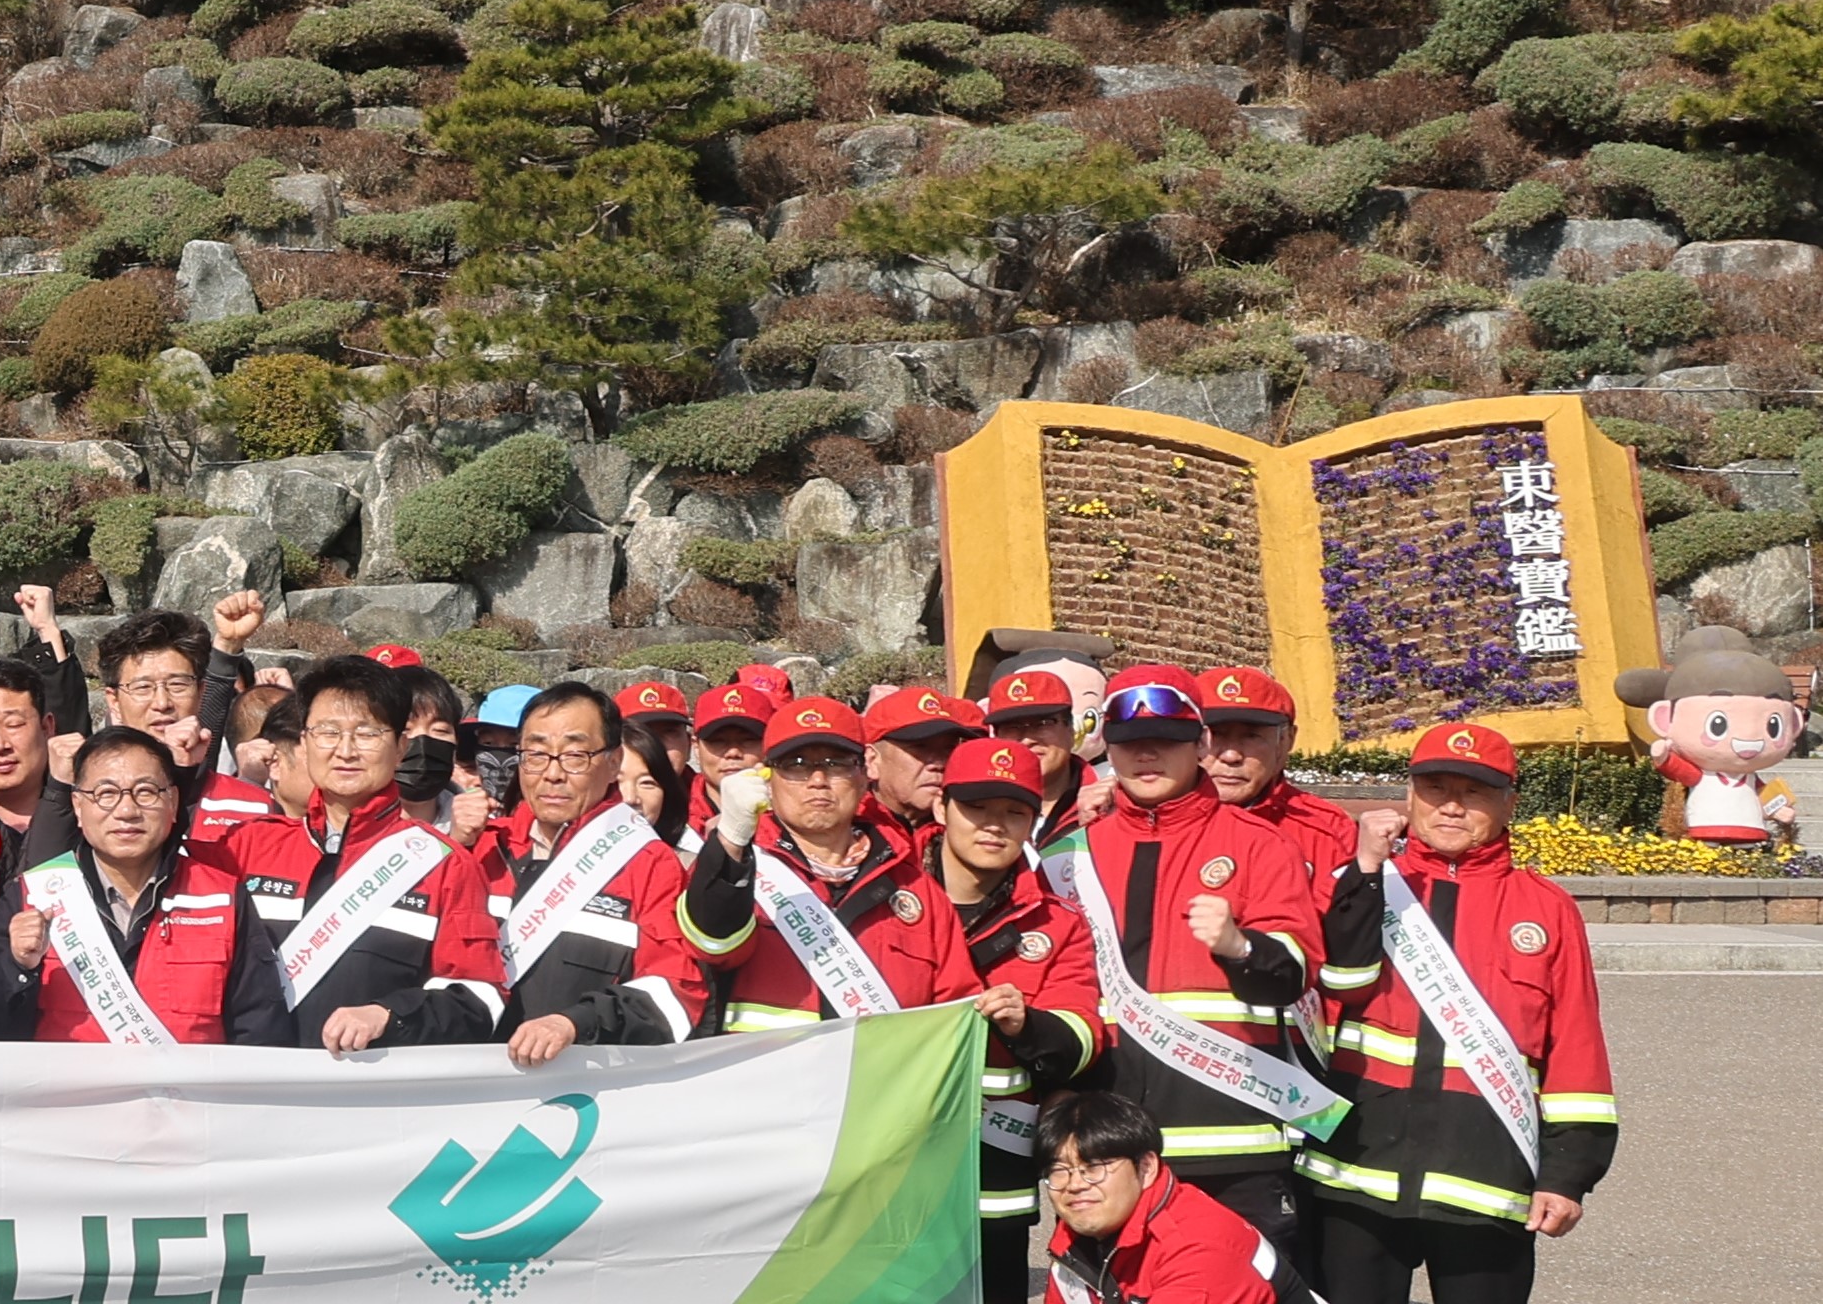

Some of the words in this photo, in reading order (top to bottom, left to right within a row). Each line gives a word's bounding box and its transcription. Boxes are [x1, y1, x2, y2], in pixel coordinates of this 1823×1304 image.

[1495, 460, 1583, 657] 東醫寶鑑
[343, 853, 409, 915] 이득없는
[575, 825, 637, 875] 이득없는
[262, 879, 294, 895] 산청군
[517, 872, 578, 942] 논밭소각
[286, 912, 342, 980] 논밭소각
[784, 909, 818, 947] 태운
[813, 945, 834, 967] 산
[826, 967, 848, 988] 그
[805, 905, 825, 926] 3년
[821, 926, 850, 957] 이하의
[73, 951, 101, 989] 태운
[97, 990, 115, 1012] 산
[108, 1011, 128, 1032] 그
[93, 947, 109, 967] 3년
[105, 968, 129, 1000] 이하의
[1389, 927, 1420, 963] 태운
[1413, 962, 1432, 983] 산
[1424, 982, 1446, 1004] 그
[1439, 1001, 1482, 1055] 실수도
[1423, 943, 1449, 973] 이하의
[1458, 995, 1479, 1019] 또는
[1475, 1018, 1509, 1059] 3천만원
[1120, 1002, 1171, 1050] 실수도
[1171, 1041, 1285, 1106] 처벌대상입니다
[1154, 1013, 1200, 1042] 3천만원
[1200, 1036, 1231, 1059] 이하의
